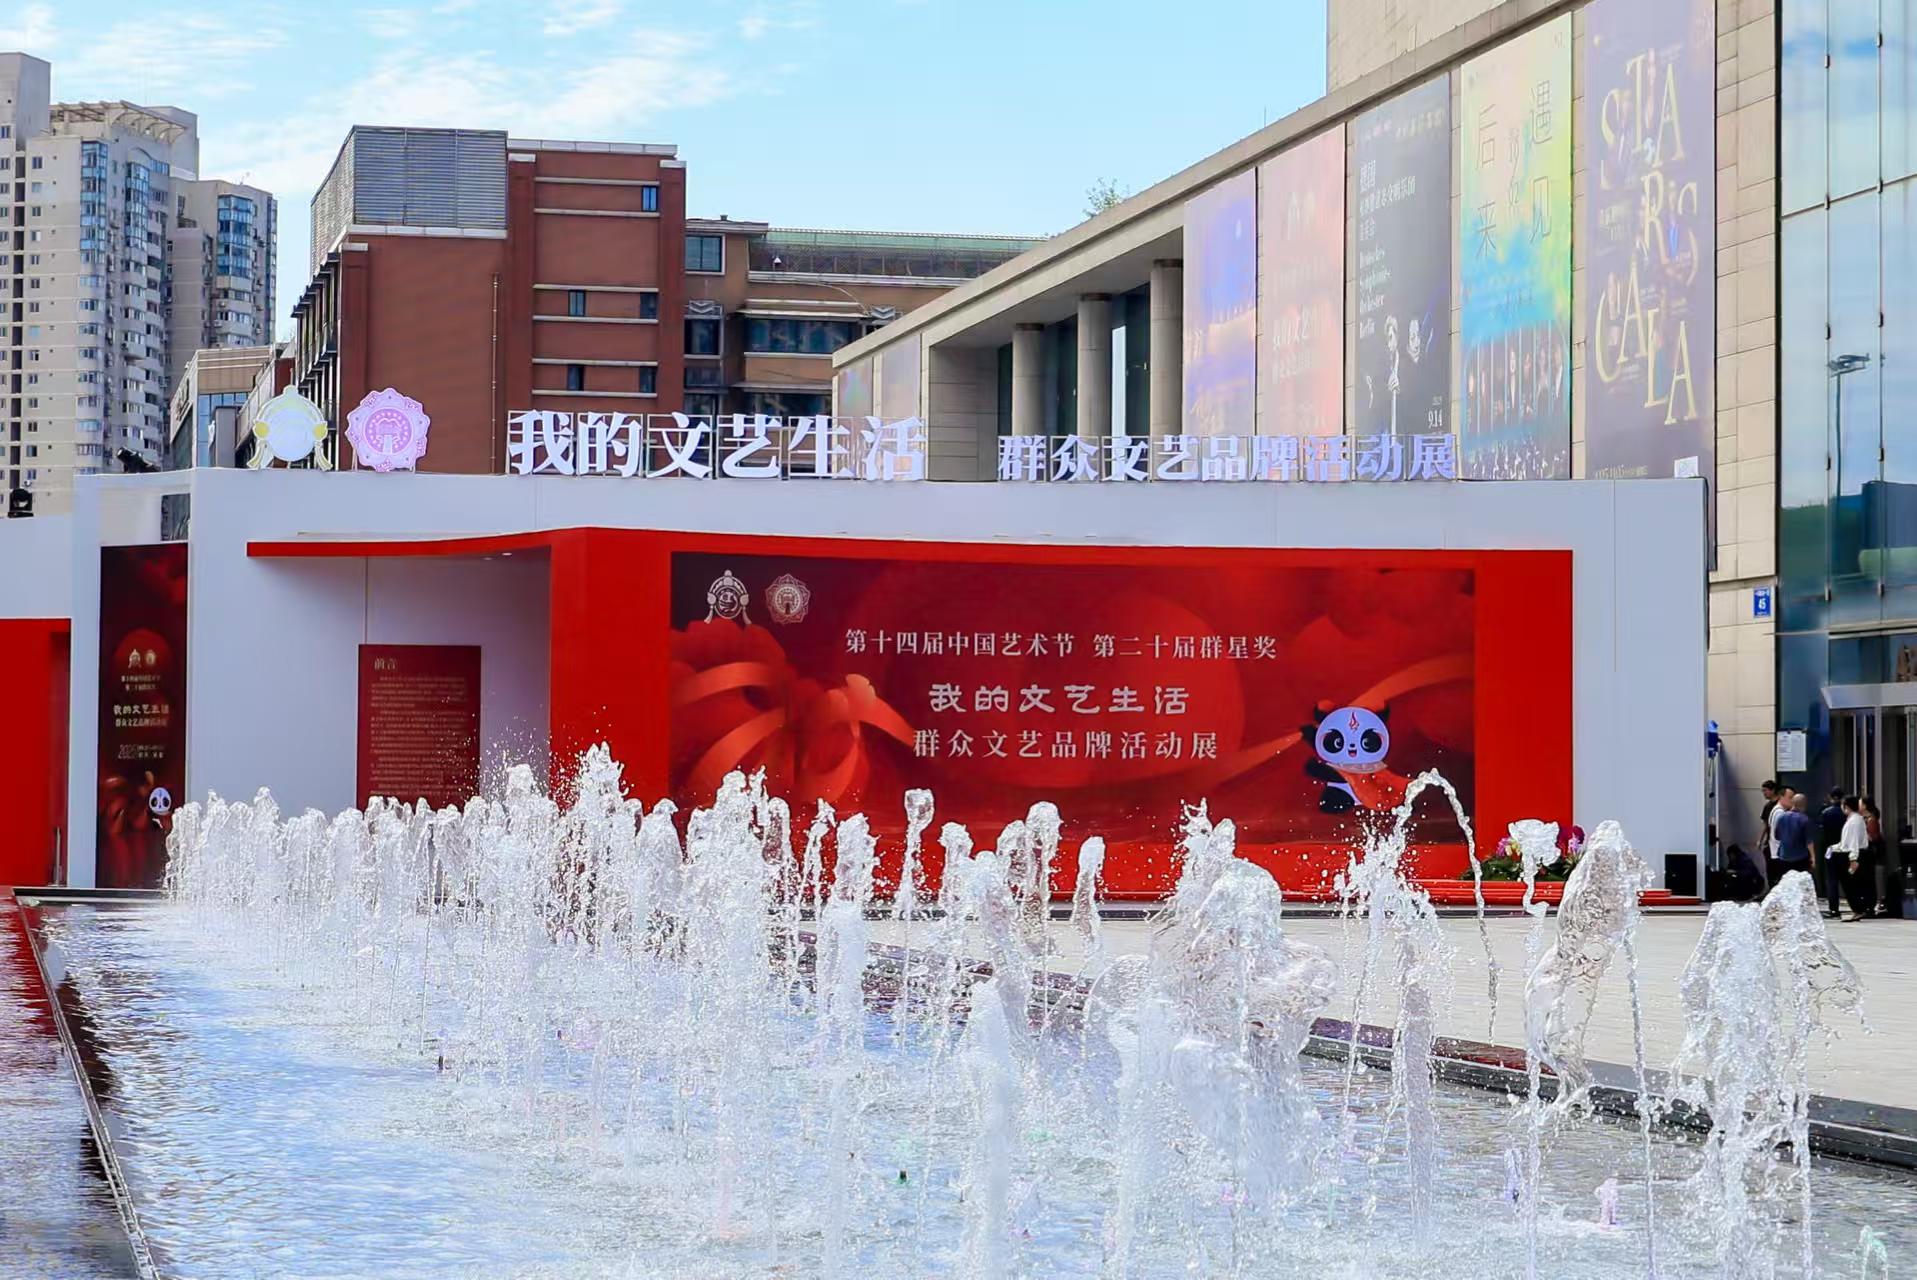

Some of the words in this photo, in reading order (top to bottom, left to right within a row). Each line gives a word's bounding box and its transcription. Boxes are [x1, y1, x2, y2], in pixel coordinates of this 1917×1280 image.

[508, 409, 927, 481] 我的文艺生活
[998, 434, 1458, 482] 群众文艺品牌活动展
[845, 629, 1075, 658] 第十四届中国艺术节
[1093, 633, 1277, 660] 第二十届群星奖
[928, 682, 1190, 715] 我的文艺生活
[912, 729, 1219, 761] 群众文艺品牌活动展
